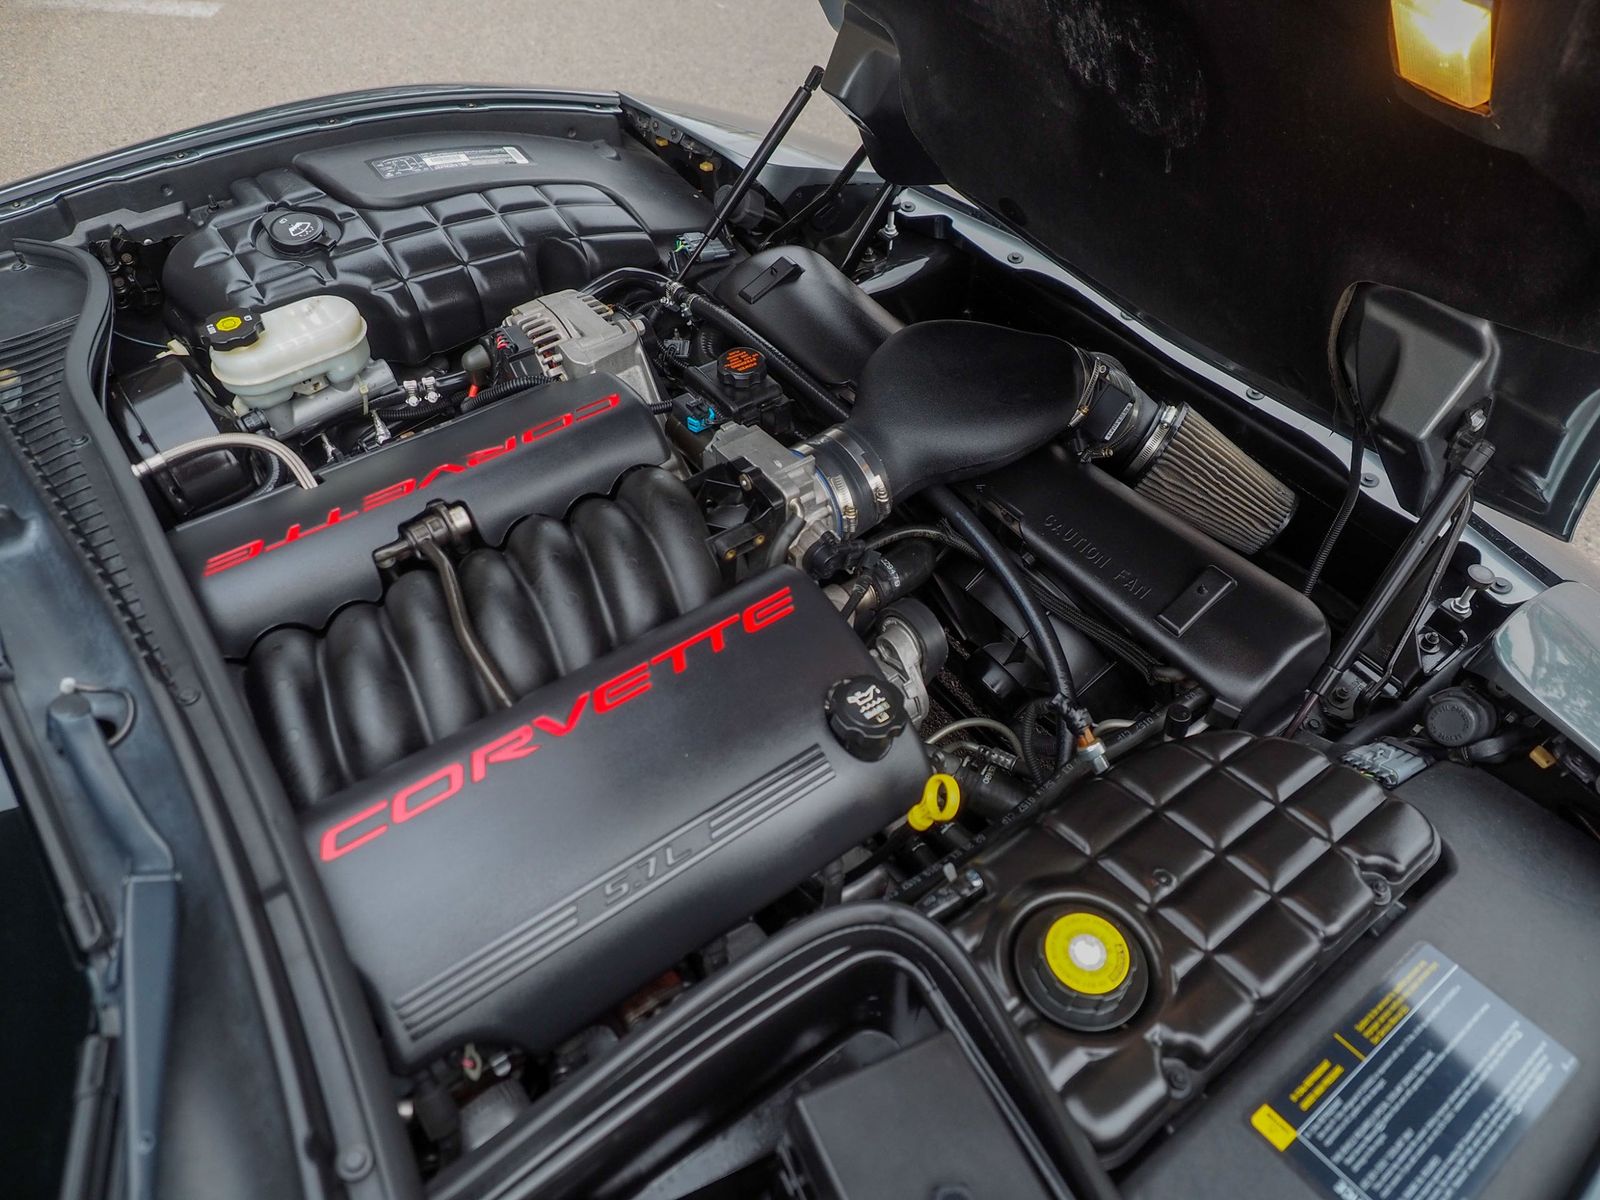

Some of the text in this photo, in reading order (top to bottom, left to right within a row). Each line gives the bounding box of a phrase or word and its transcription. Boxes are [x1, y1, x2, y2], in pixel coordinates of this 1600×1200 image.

[203, 393, 620, 577] CORVETTE
[1044, 513, 1153, 600] CAUTION FAN
[319, 586, 795, 862] CORVETTE
[603, 846, 693, 907] 5.7L
